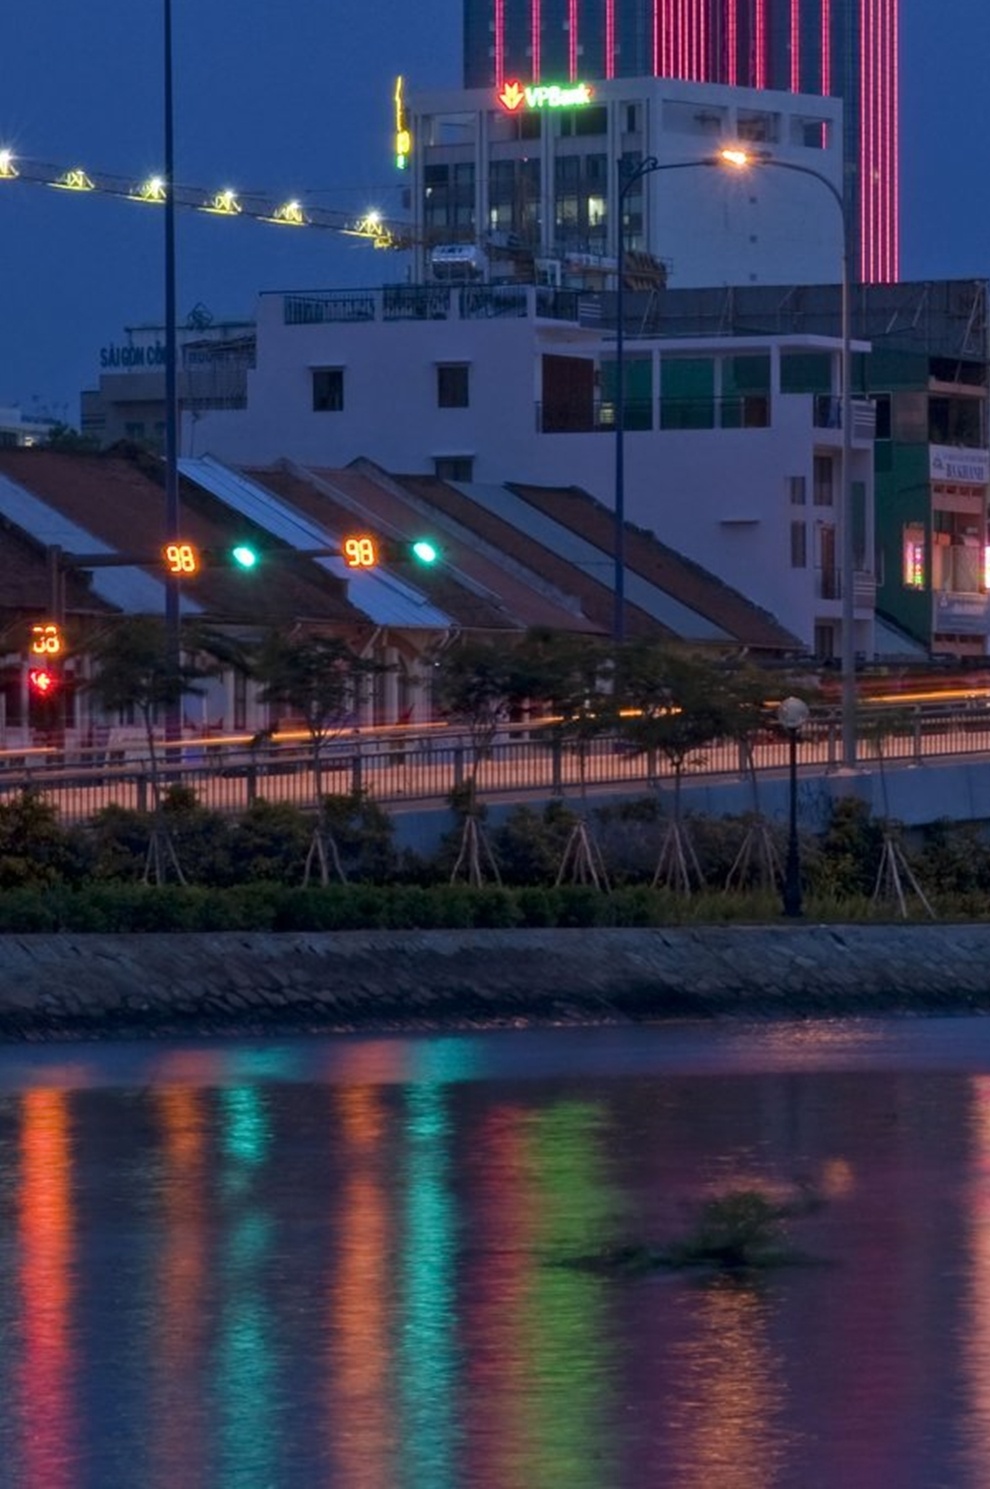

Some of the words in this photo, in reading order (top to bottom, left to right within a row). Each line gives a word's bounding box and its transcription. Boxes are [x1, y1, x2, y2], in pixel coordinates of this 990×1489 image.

[524, 83, 591, 108] VPBank
[166, 545, 196, 573] 98
[344, 538, 375, 566] 98
